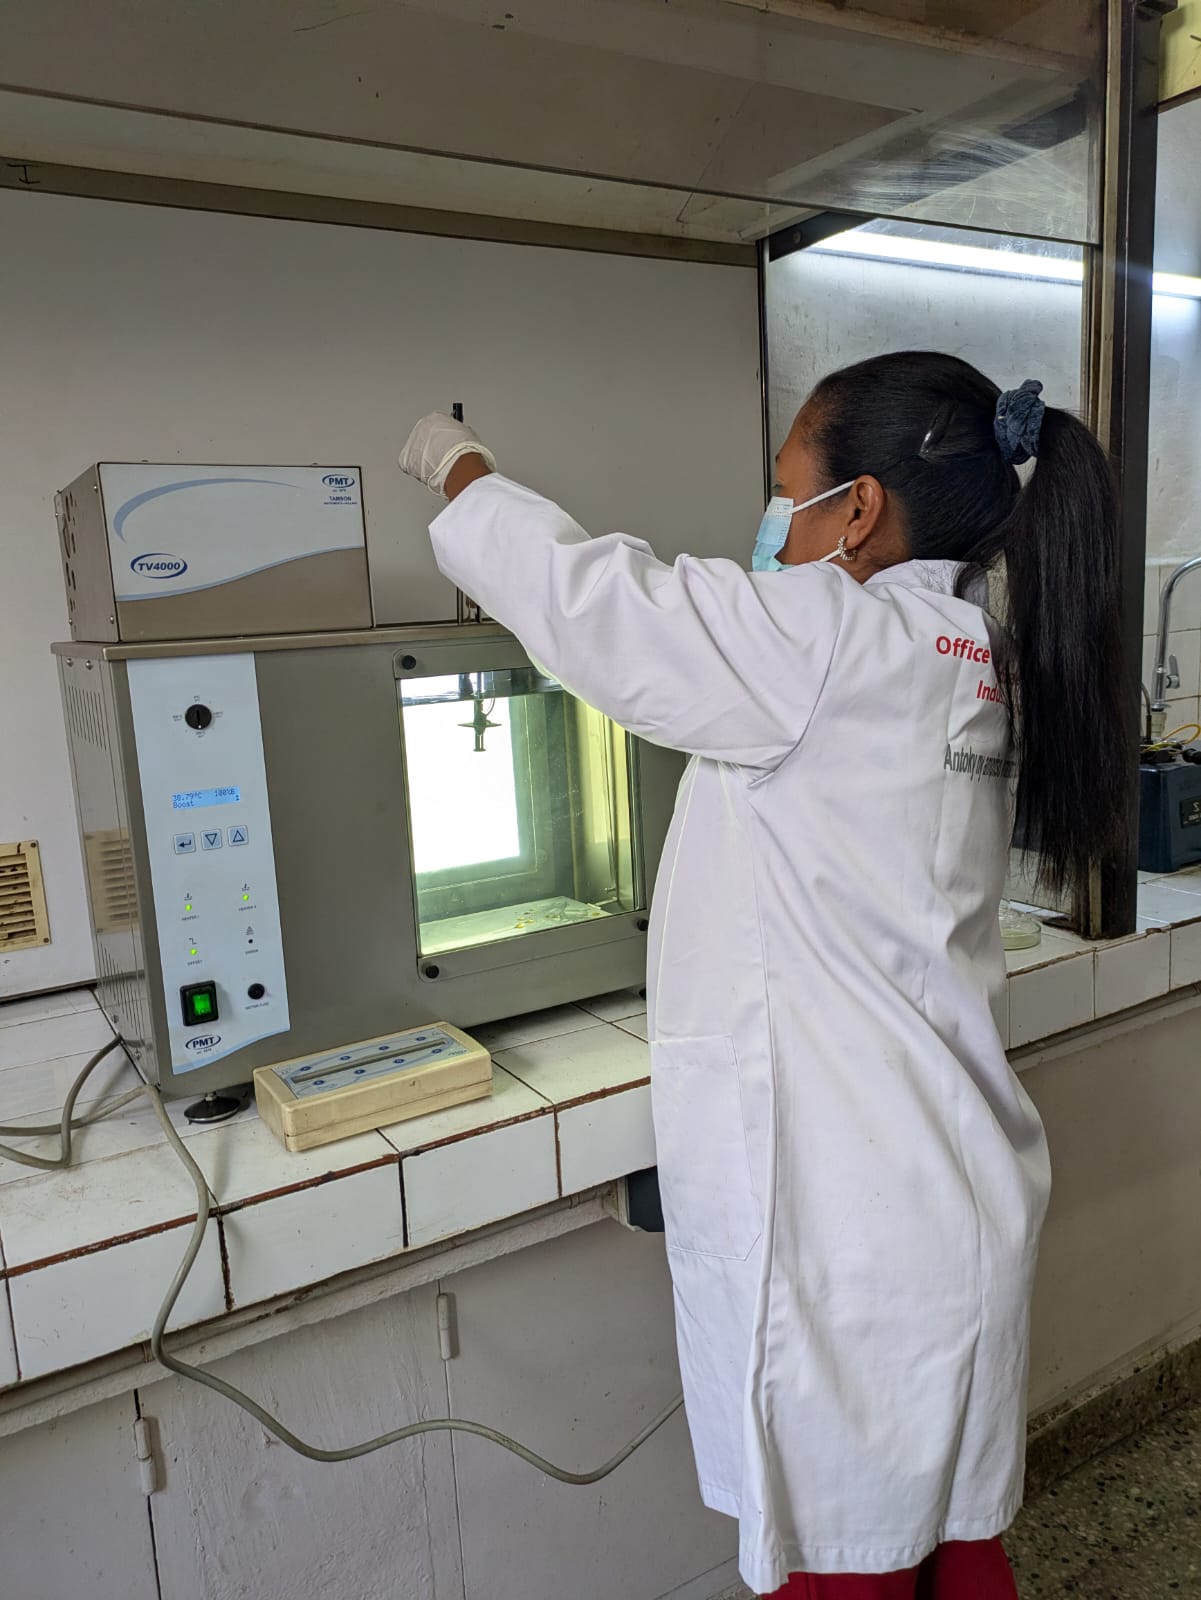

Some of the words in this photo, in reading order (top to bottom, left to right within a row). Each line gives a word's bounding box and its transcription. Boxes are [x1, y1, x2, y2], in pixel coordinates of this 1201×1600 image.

[328, 477, 349, 485] PMT
[137, 562, 181, 571] TV4000
[936, 636, 990, 664] Office
[173, 800, 194, 809] Boost
[192, 1036, 216, 1048] PMT
